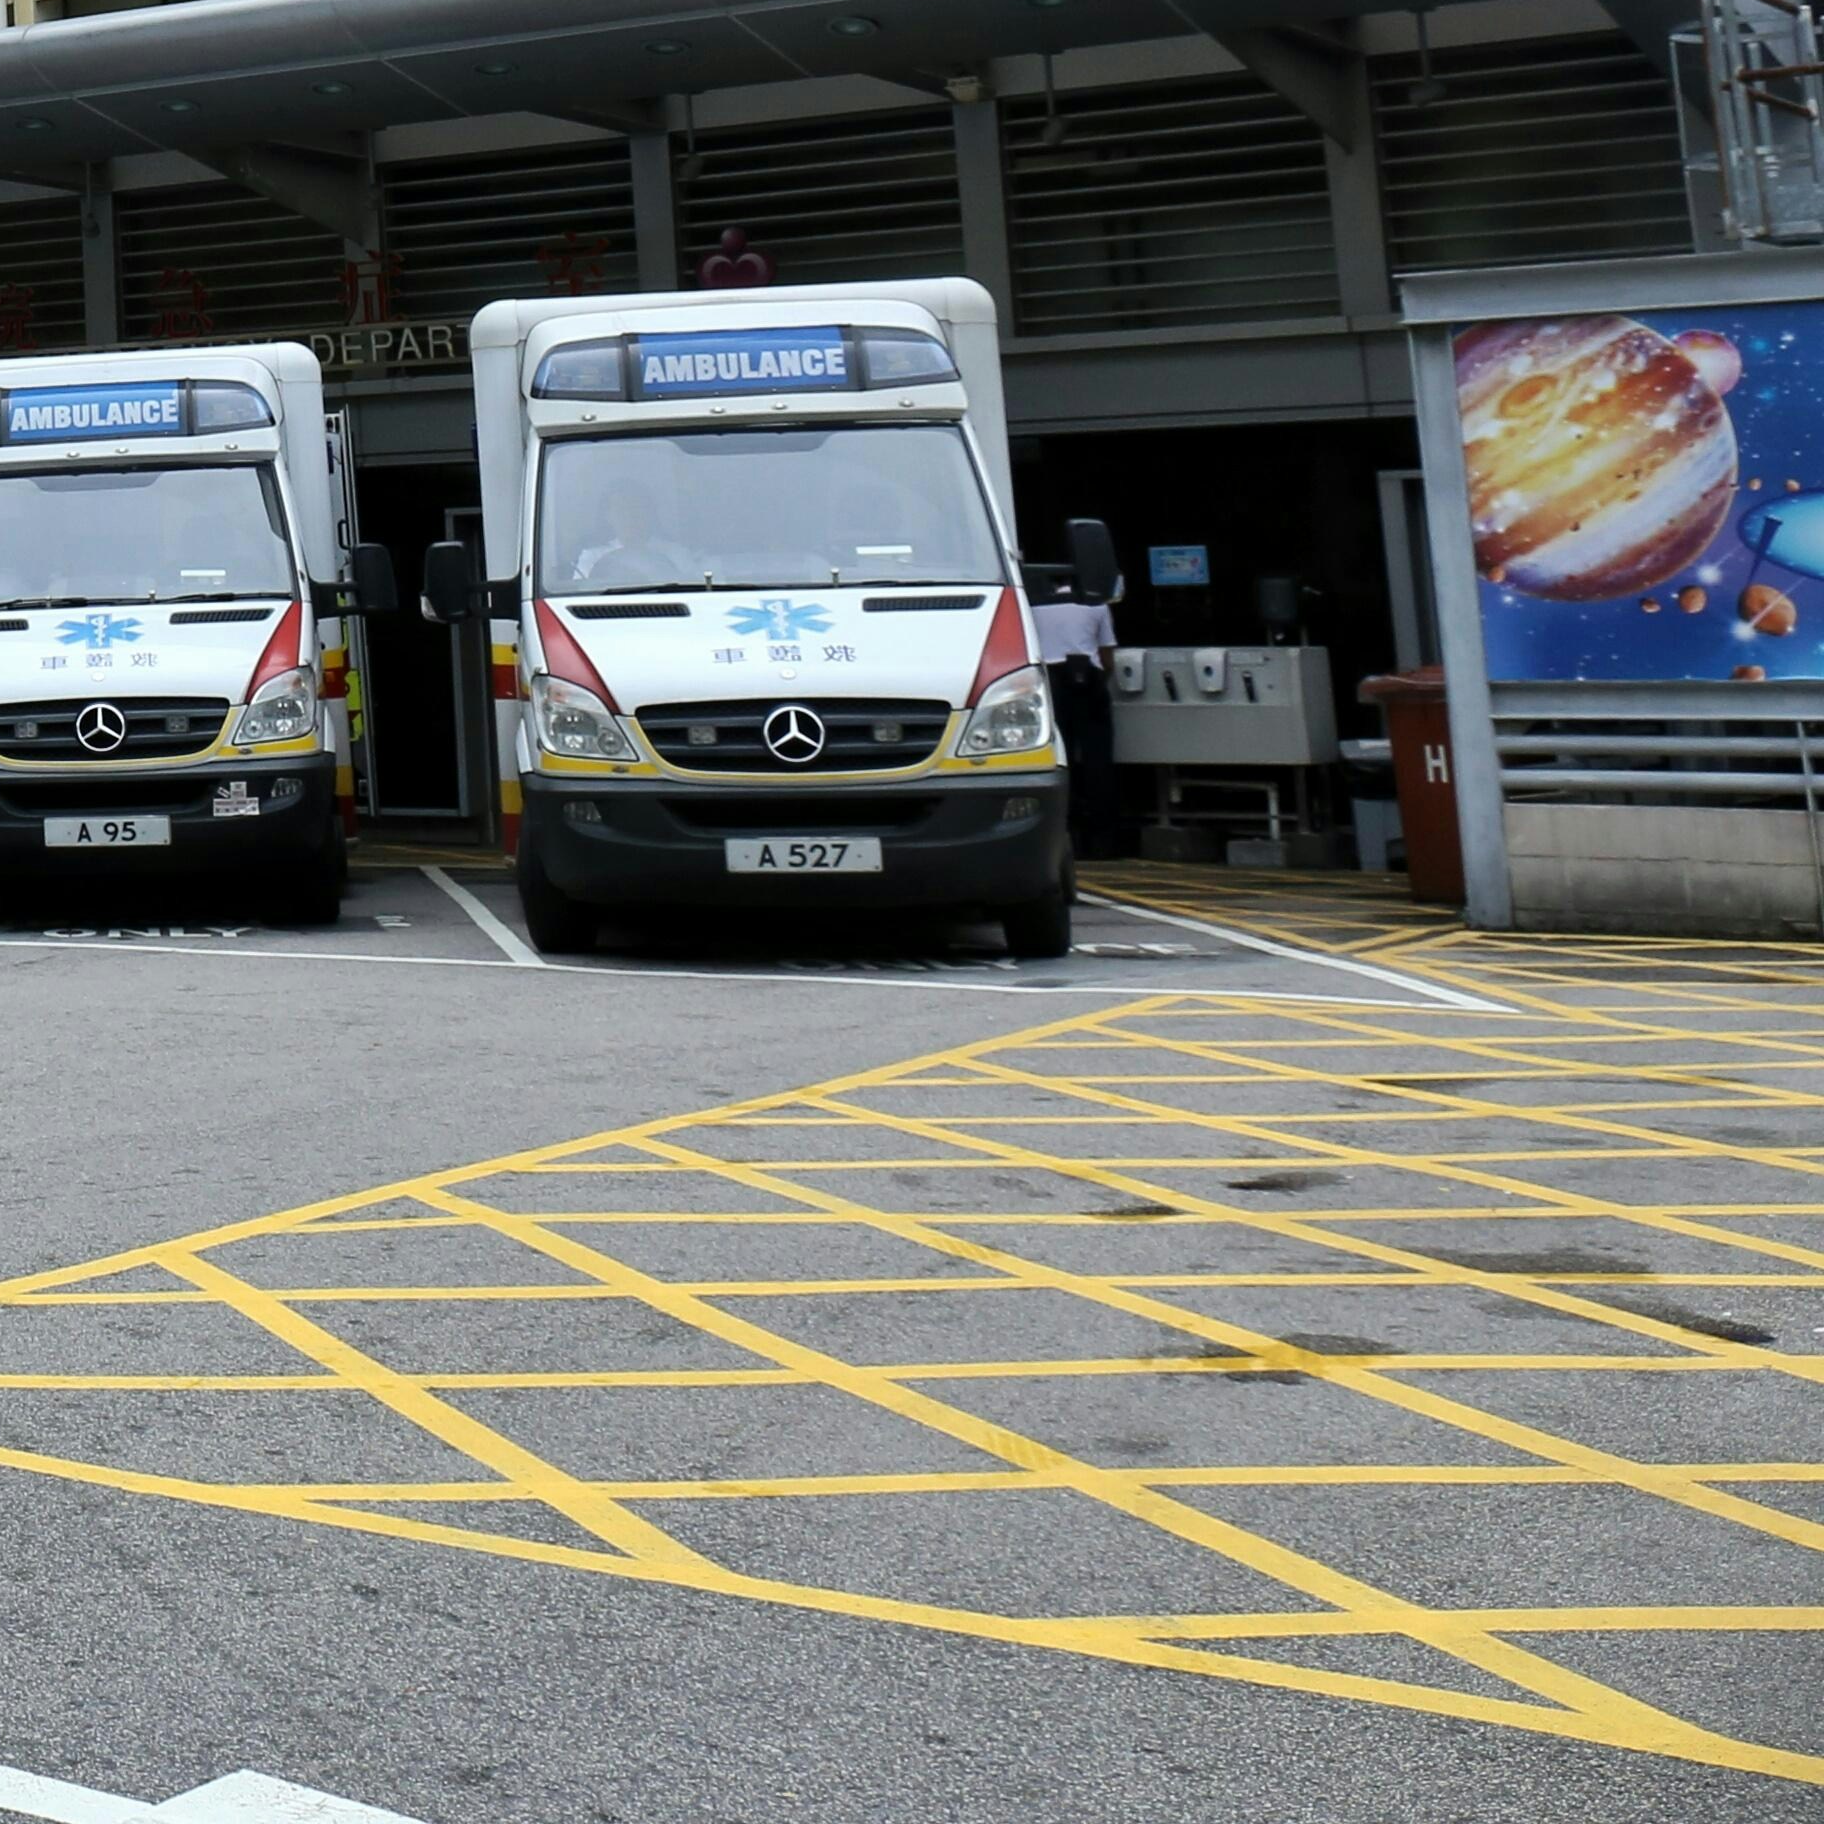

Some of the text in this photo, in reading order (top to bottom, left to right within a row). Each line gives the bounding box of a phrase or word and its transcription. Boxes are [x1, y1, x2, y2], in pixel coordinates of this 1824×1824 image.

[309, 323, 471, 365] DEPART
[643, 348, 847, 384] AMBULANCE
[10, 399, 179, 432] AMBULANCE
[1424, 744, 1448, 783] H
[77, 822, 137, 842] A 95
[758, 843, 849, 869] A 527
[43, 927, 252, 938] ONLY
